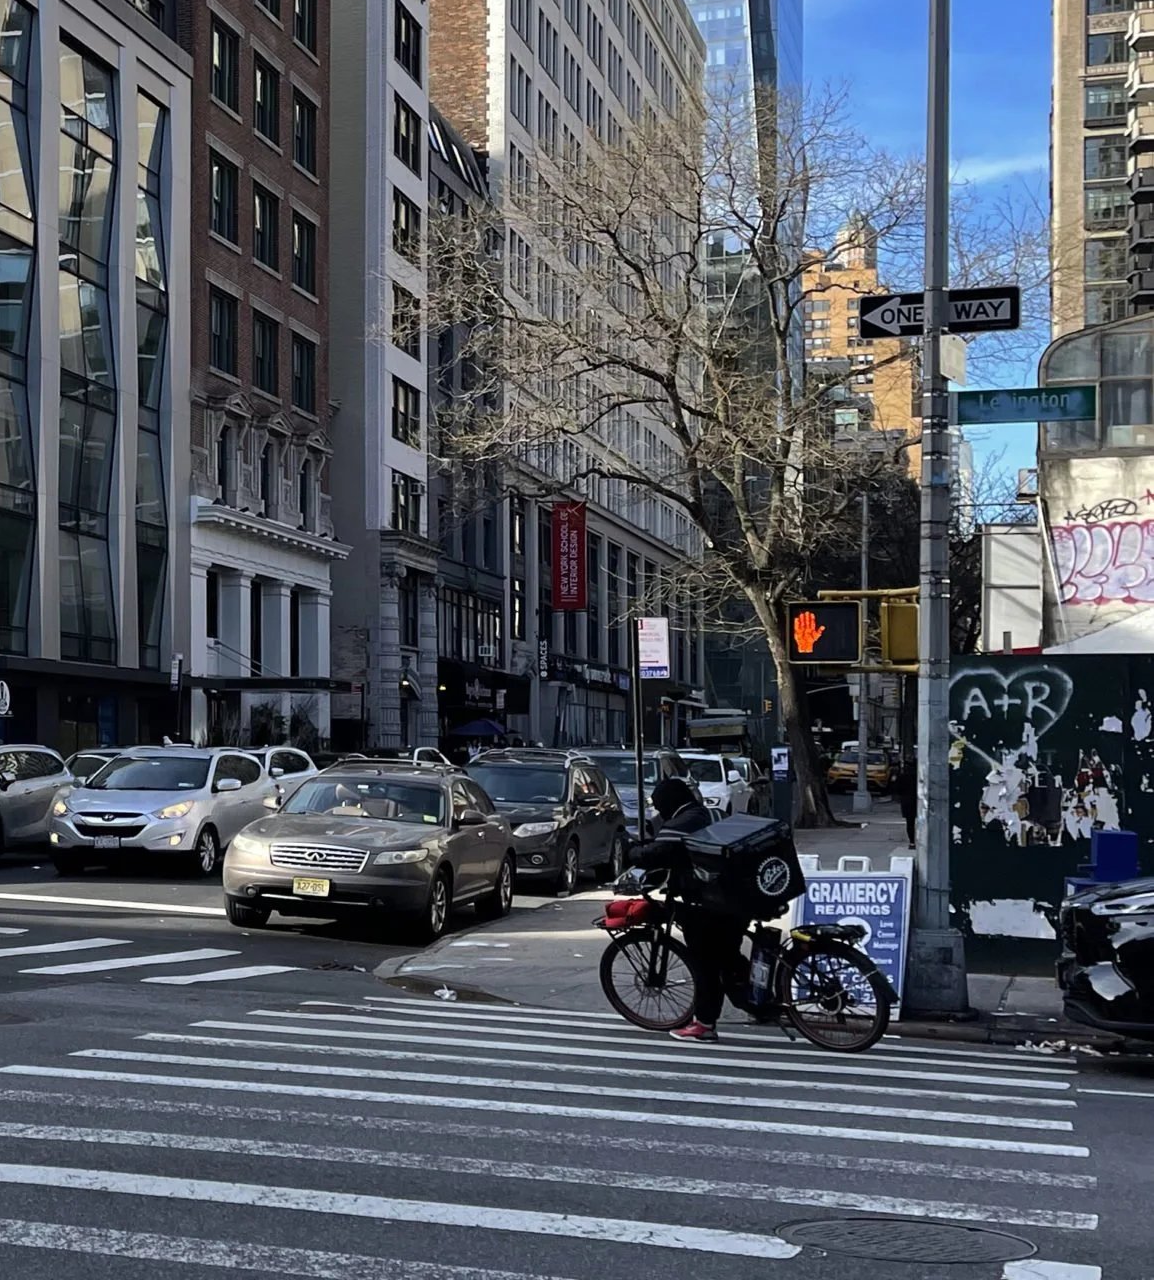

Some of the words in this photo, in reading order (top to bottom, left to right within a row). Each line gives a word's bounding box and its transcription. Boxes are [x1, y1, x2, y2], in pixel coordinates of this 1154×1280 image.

[880, 302, 924, 324] ONE
[954, 300, 1005, 319] WAY
[560, 523, 568, 553] SCHOOL
[569, 530, 578, 558] DESIGN
[560, 554, 568, 575] YORK
[560, 577, 568, 595] NEW
[569, 560, 578, 595] INTERIOR
[808, 882, 899, 903] GRAMERCY
[814, 905, 891, 915] READINGS
